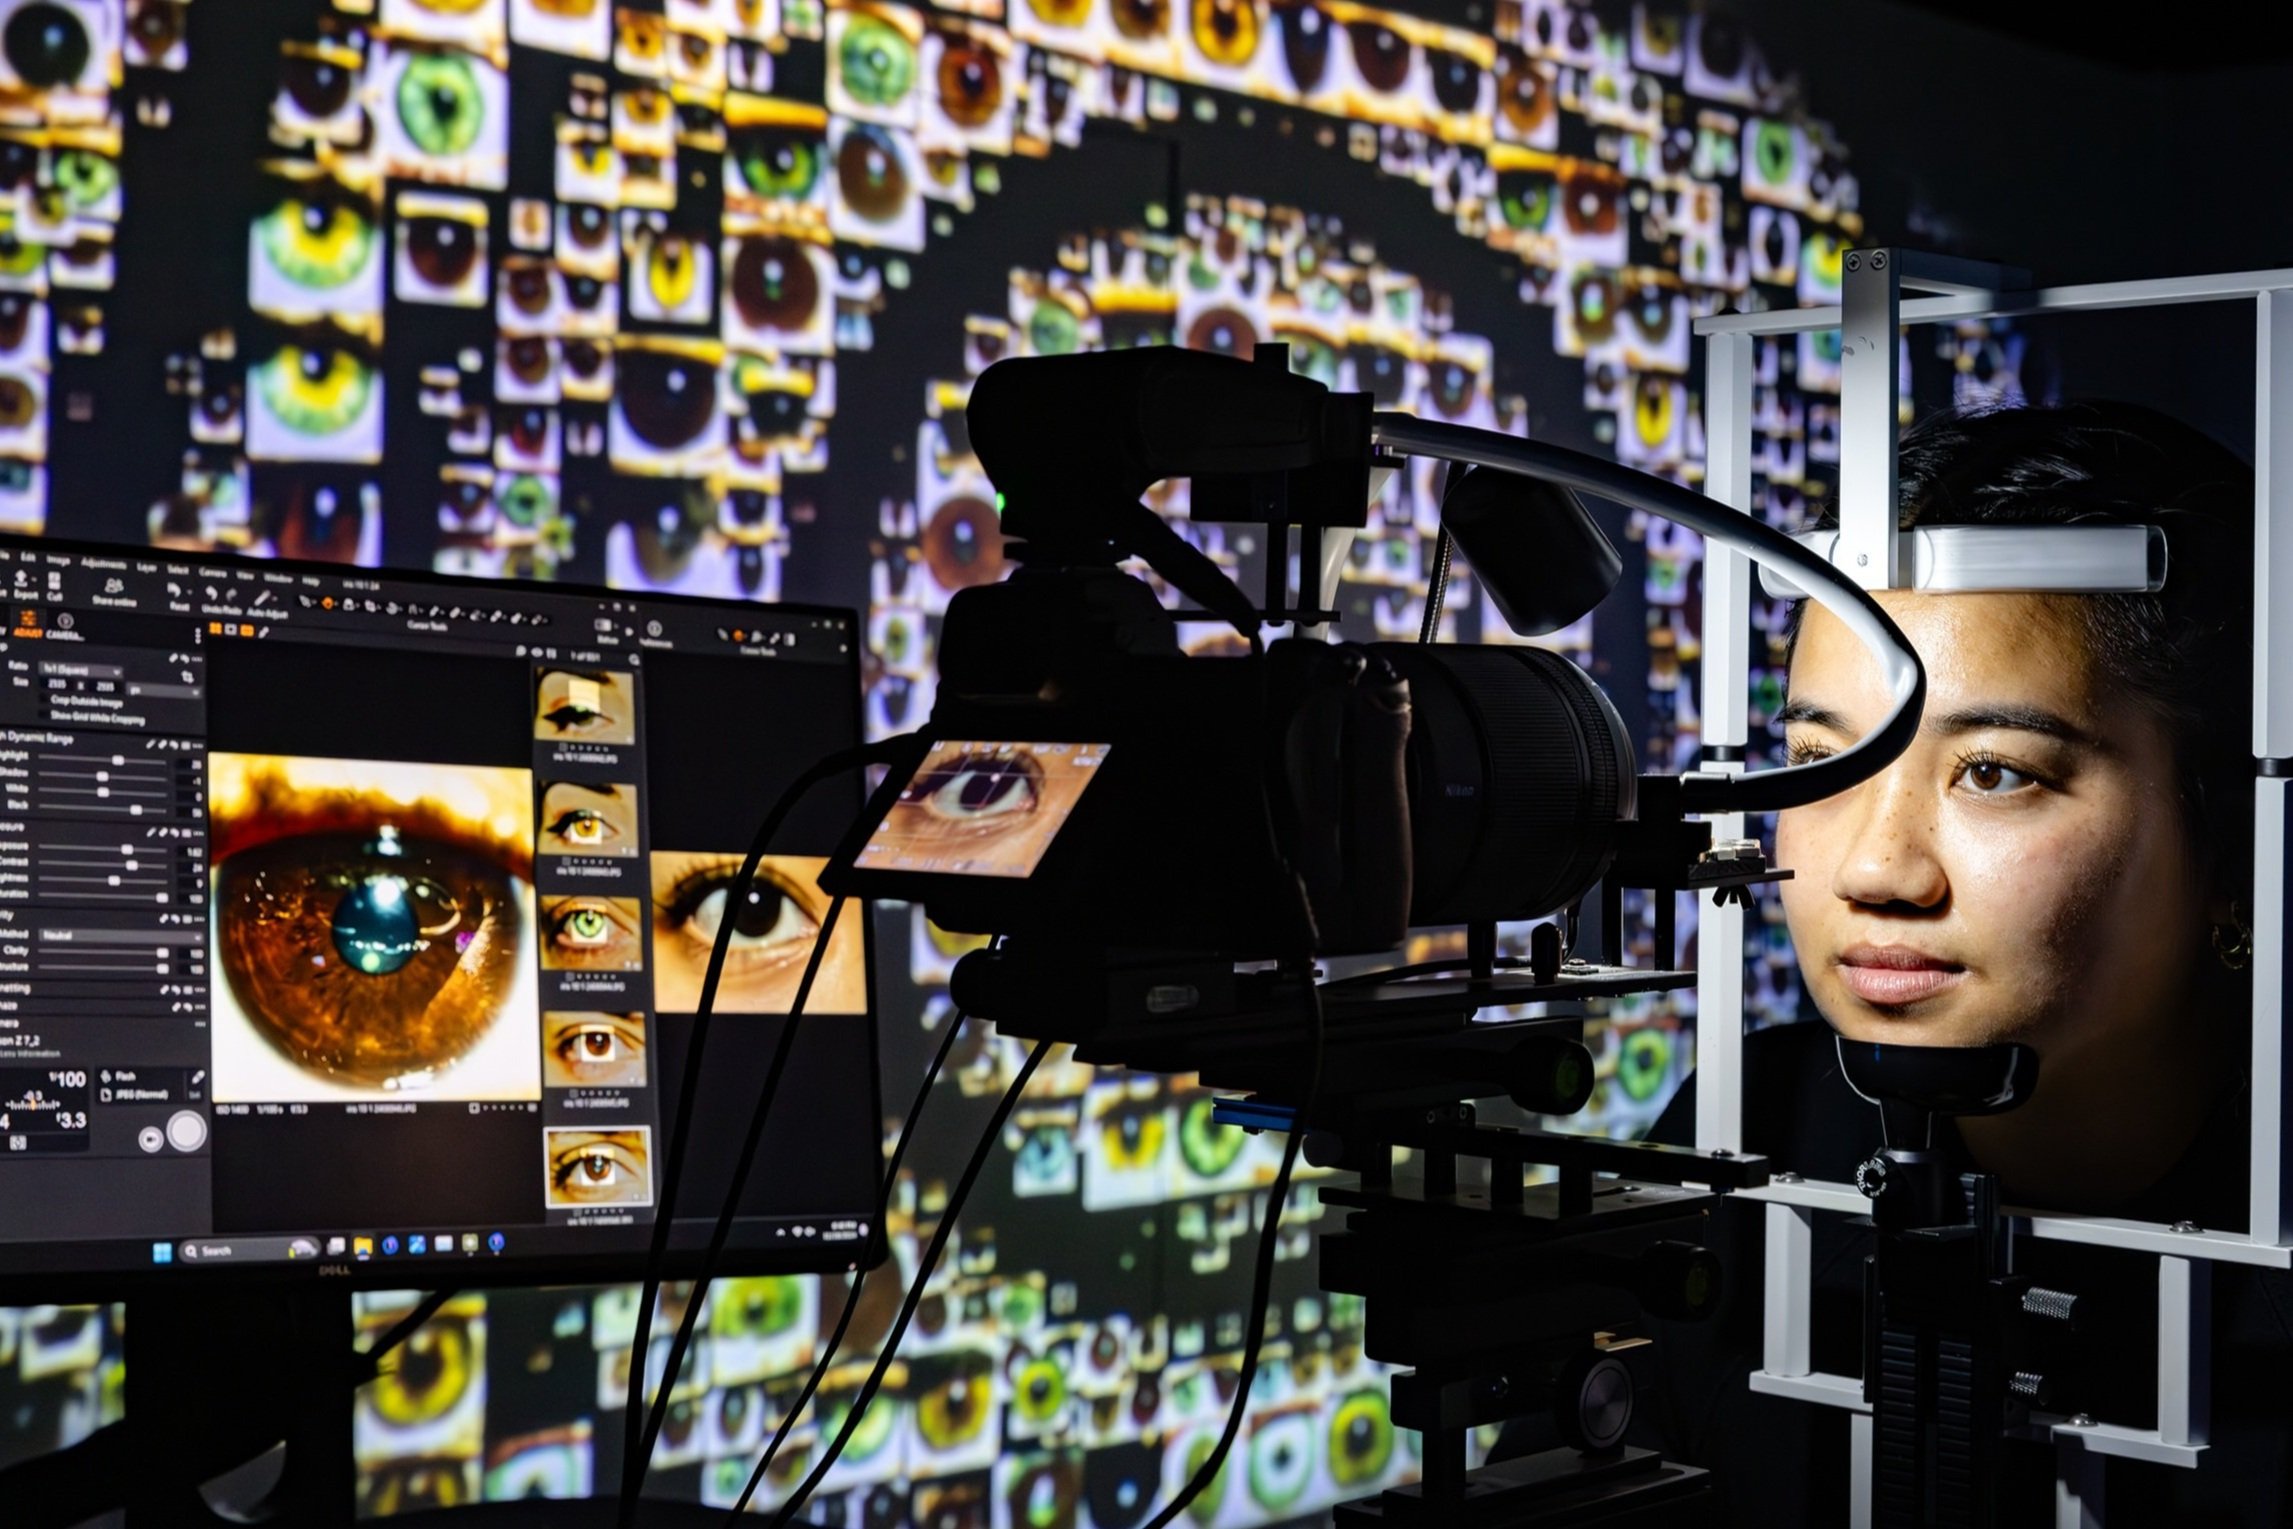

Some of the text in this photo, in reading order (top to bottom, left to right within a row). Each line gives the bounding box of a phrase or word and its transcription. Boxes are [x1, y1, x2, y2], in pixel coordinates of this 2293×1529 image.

[47, 555, 71, 567] Image
[81, 557, 127, 570] Adjustments
[137, 562, 157, 573] Layer
[14, 588, 39, 600] Export
[8, 660, 29, 671] Ratio
[51, 694, 124, 710] Crop Outside Image
[51, 710, 71, 721] Show
[72, 711, 89, 722] Grid
[111, 713, 146, 727] Cropping
[8, 730, 45, 743] Dynamic
[46, 732, 74, 746] Range
[6, 783, 29, 793] White
[1444, 784, 1475, 798] Nikon
[7, 799, 29, 810] Black
[3, 945, 29, 957] Clarity
[202, 1245, 232, 1257] Search
[319, 1264, 351, 1276] DELL
